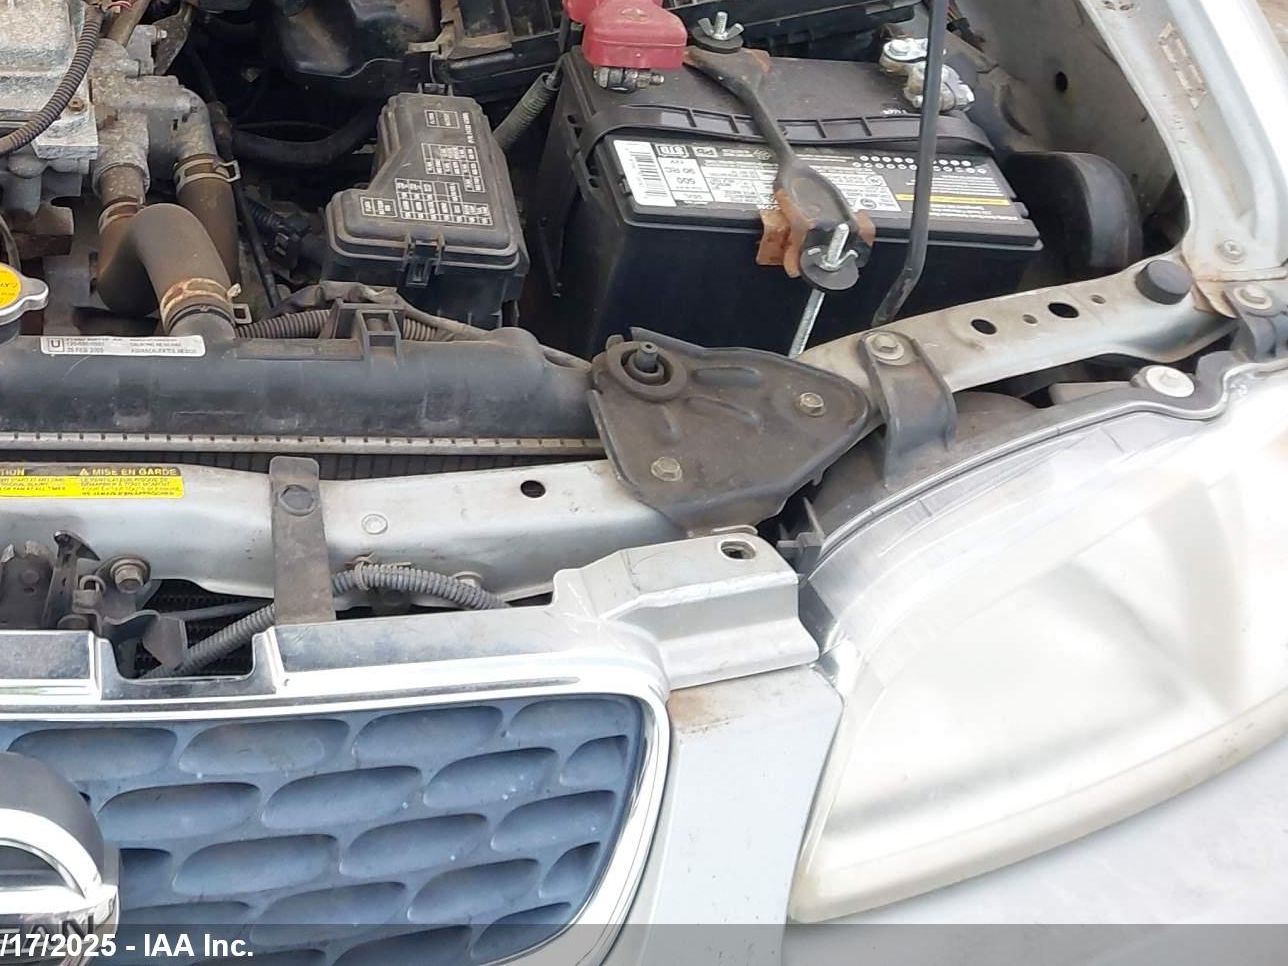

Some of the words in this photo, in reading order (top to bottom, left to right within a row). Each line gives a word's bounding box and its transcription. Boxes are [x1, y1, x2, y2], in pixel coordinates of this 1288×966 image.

[92, 467, 118, 476] MISE
[121, 467, 136, 476] EN
[138, 467, 177, 476] GARDE
